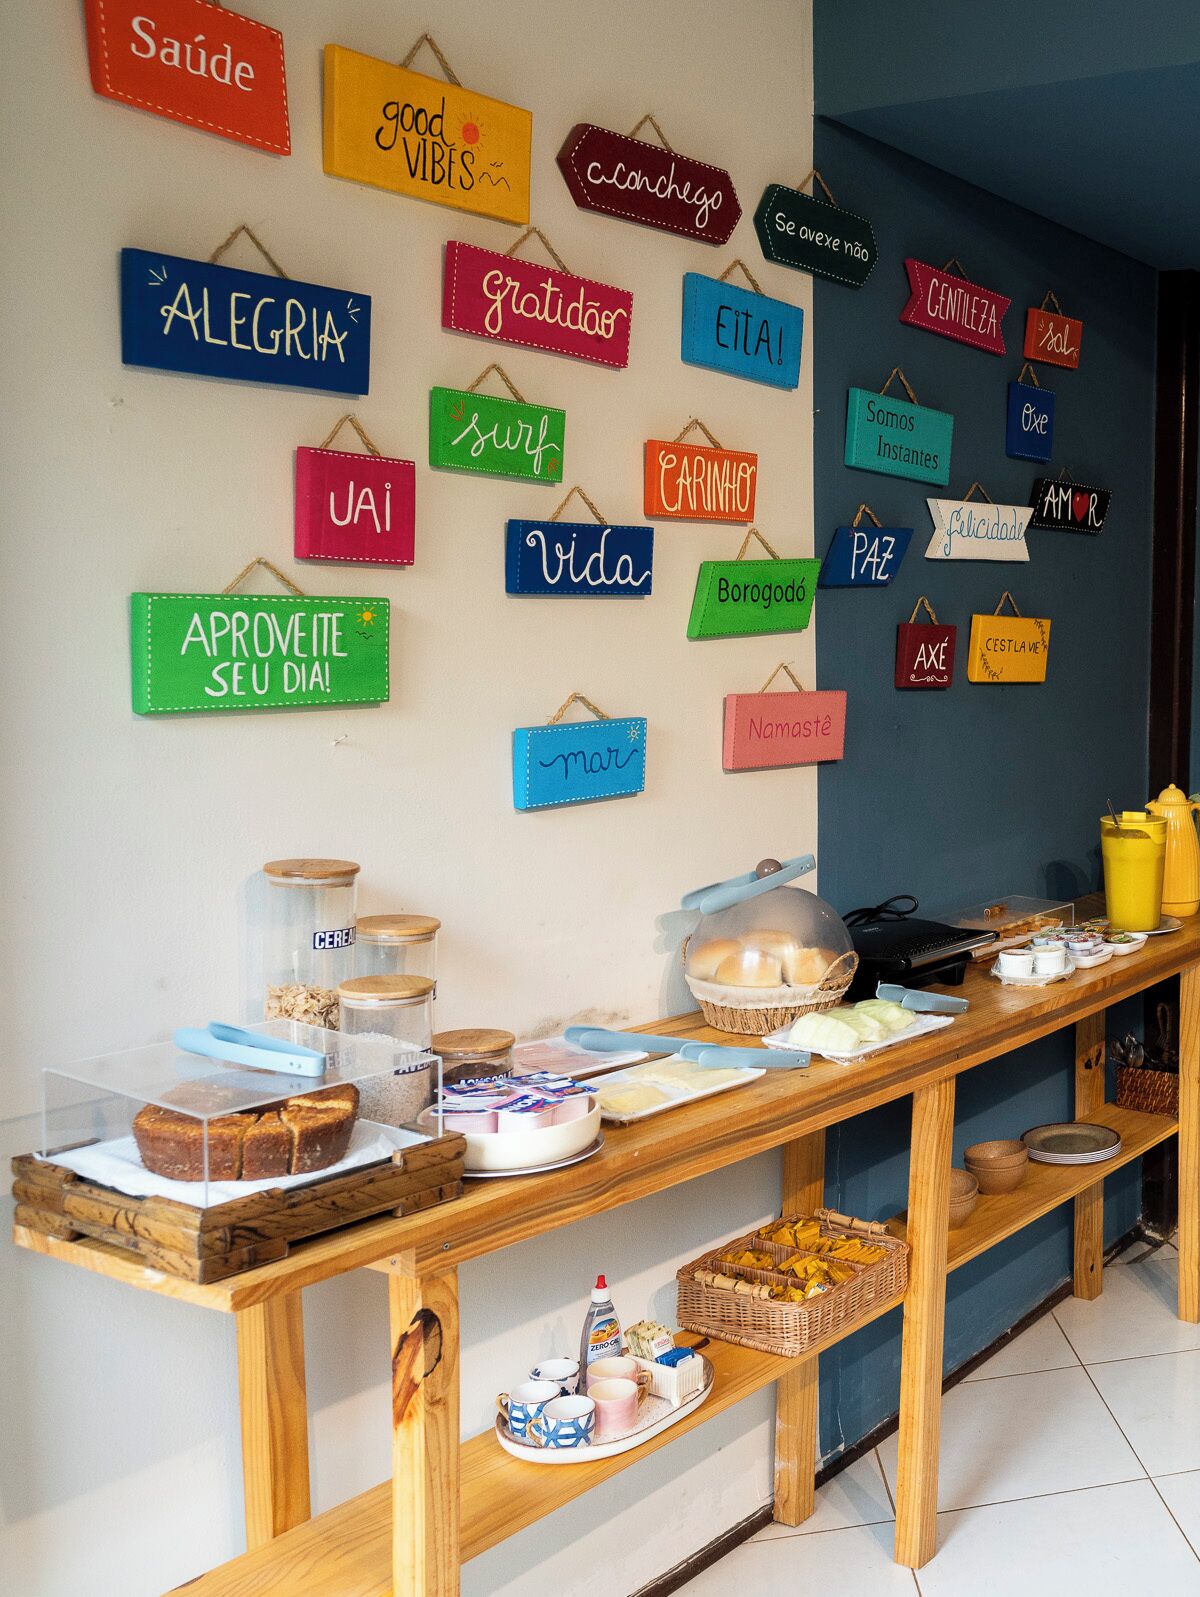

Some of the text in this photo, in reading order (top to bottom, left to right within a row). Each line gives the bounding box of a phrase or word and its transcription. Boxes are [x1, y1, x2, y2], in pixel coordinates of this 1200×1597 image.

[129, 15, 256, 92] Saúde
[375, 97, 454, 150] good
[402, 136, 476, 191] VIBES
[587, 161, 723, 228] aconchego
[775, 212, 869, 262] Se avexe não
[160, 282, 348, 363] ALEGRIA
[482, 269, 627, 340] gratidão
[866, 400, 915, 432] Somos
[1021, 402, 1049, 435] Oxe
[451, 413, 561, 476] surf
[877, 434, 939, 470] Instantes
[658, 450, 756, 512] CARINHO
[851, 532, 896, 580] PAZ
[717, 576, 807, 610] Borogodó
[180, 610, 349, 658] APROVEITE
[913, 636, 949, 671] AXÉ
[204, 660, 331, 697] SEU DIA!
[748, 716, 833, 742] Namastê
[538, 749, 640, 781] mar
